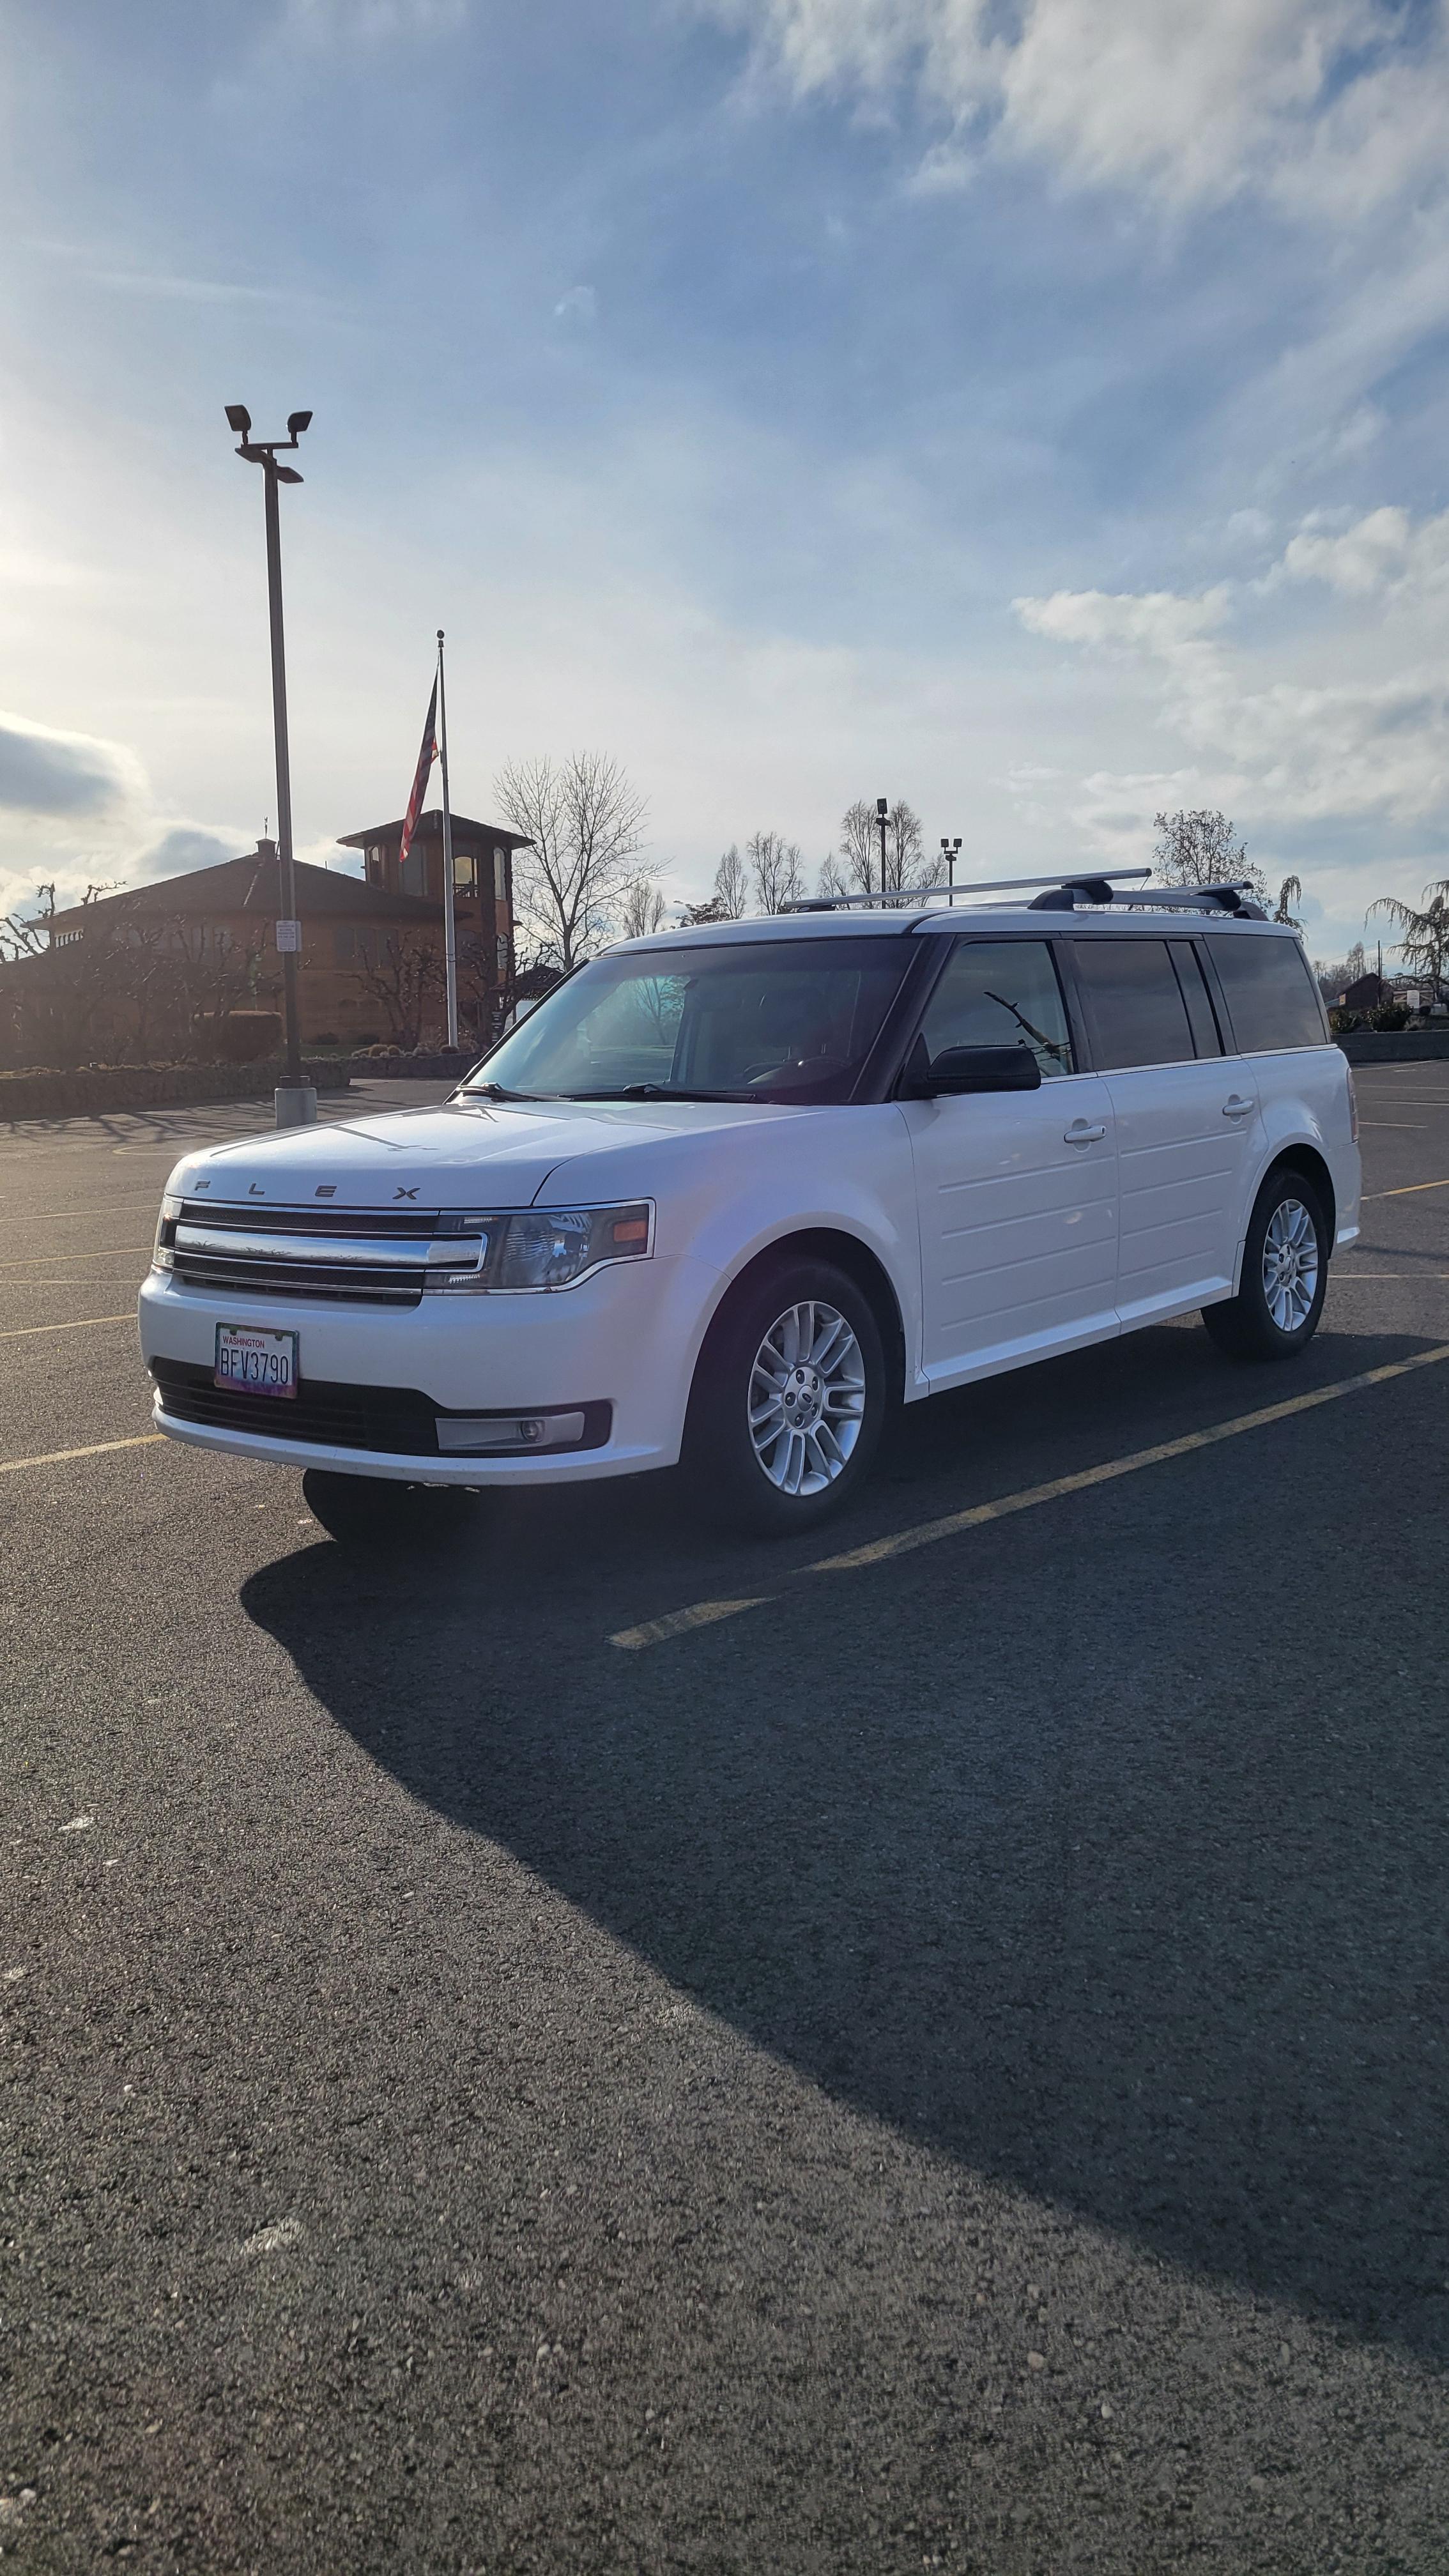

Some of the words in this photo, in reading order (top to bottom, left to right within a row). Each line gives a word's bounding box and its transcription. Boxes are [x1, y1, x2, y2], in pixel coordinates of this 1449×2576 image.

[194, 1180, 421, 1200] FLEX
[223, 1336, 264, 1348] WASHINGTON
[221, 1347, 288, 1384] BFV3790
